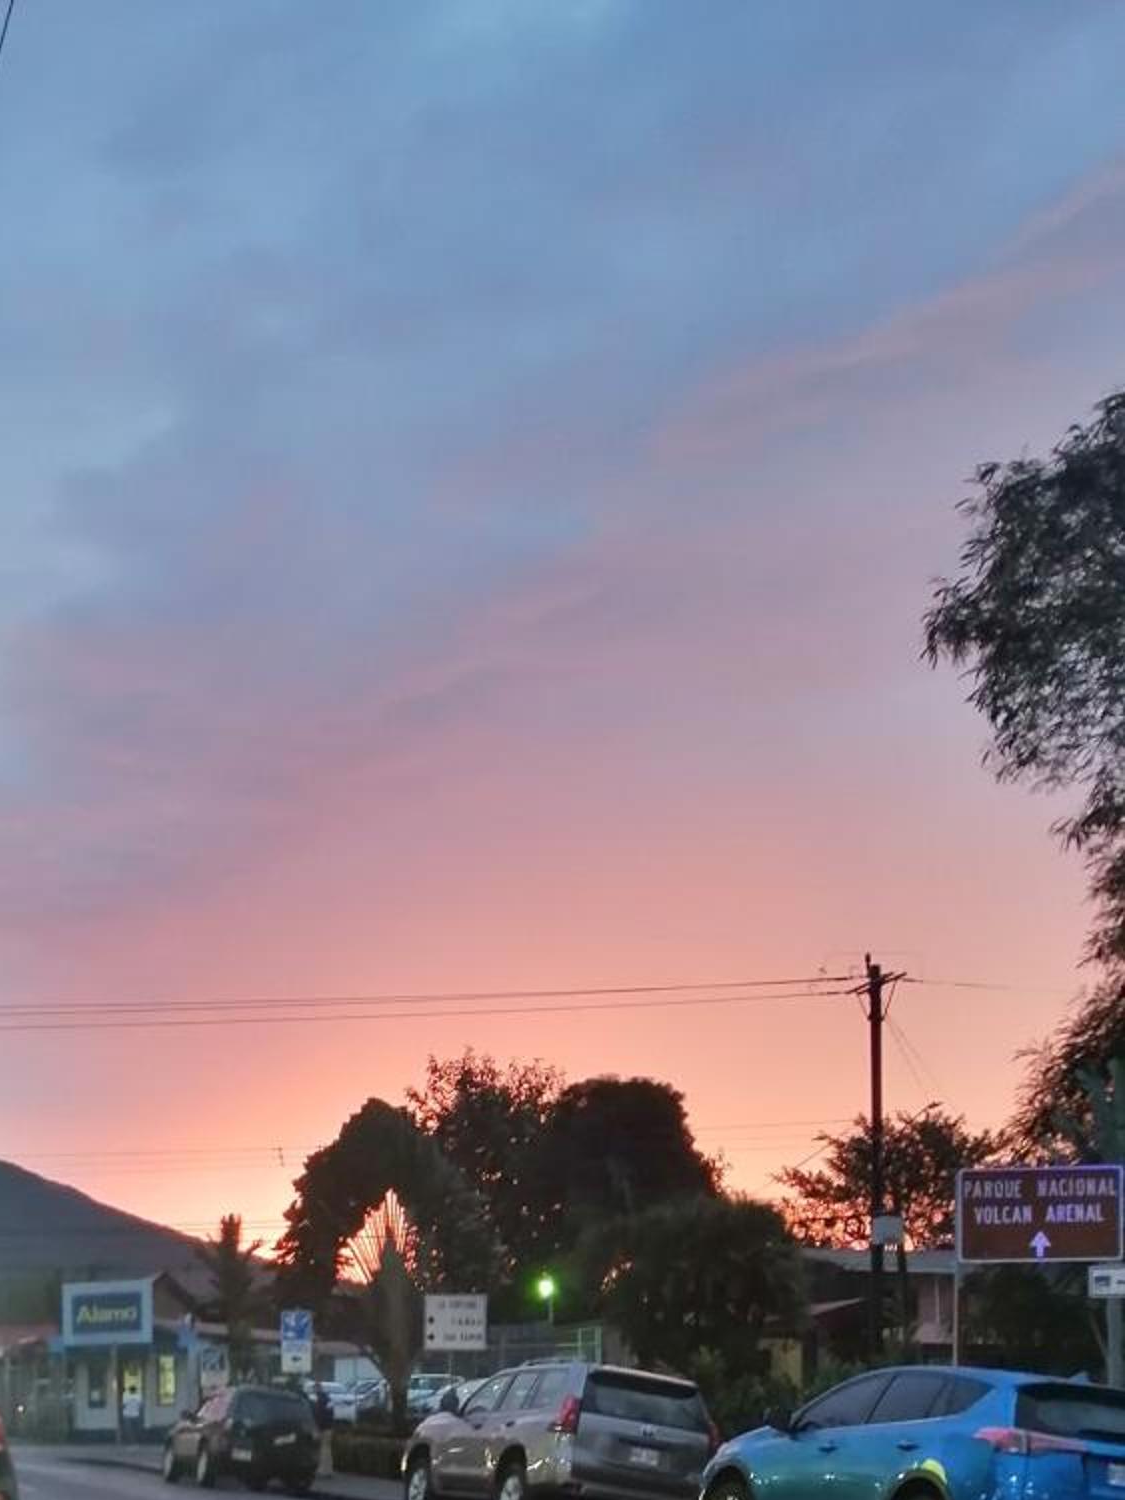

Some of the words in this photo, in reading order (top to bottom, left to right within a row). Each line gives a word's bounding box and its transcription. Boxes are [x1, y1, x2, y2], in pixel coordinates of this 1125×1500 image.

[963, 1179, 1023, 1198] PARQUE
[1036, 1177, 1116, 1197] NACIONAL
[974, 1204, 1033, 1225] VOLCAN
[1045, 1202, 1105, 1223] ARENAL
[76, 1304, 138, 1326] Alamo
